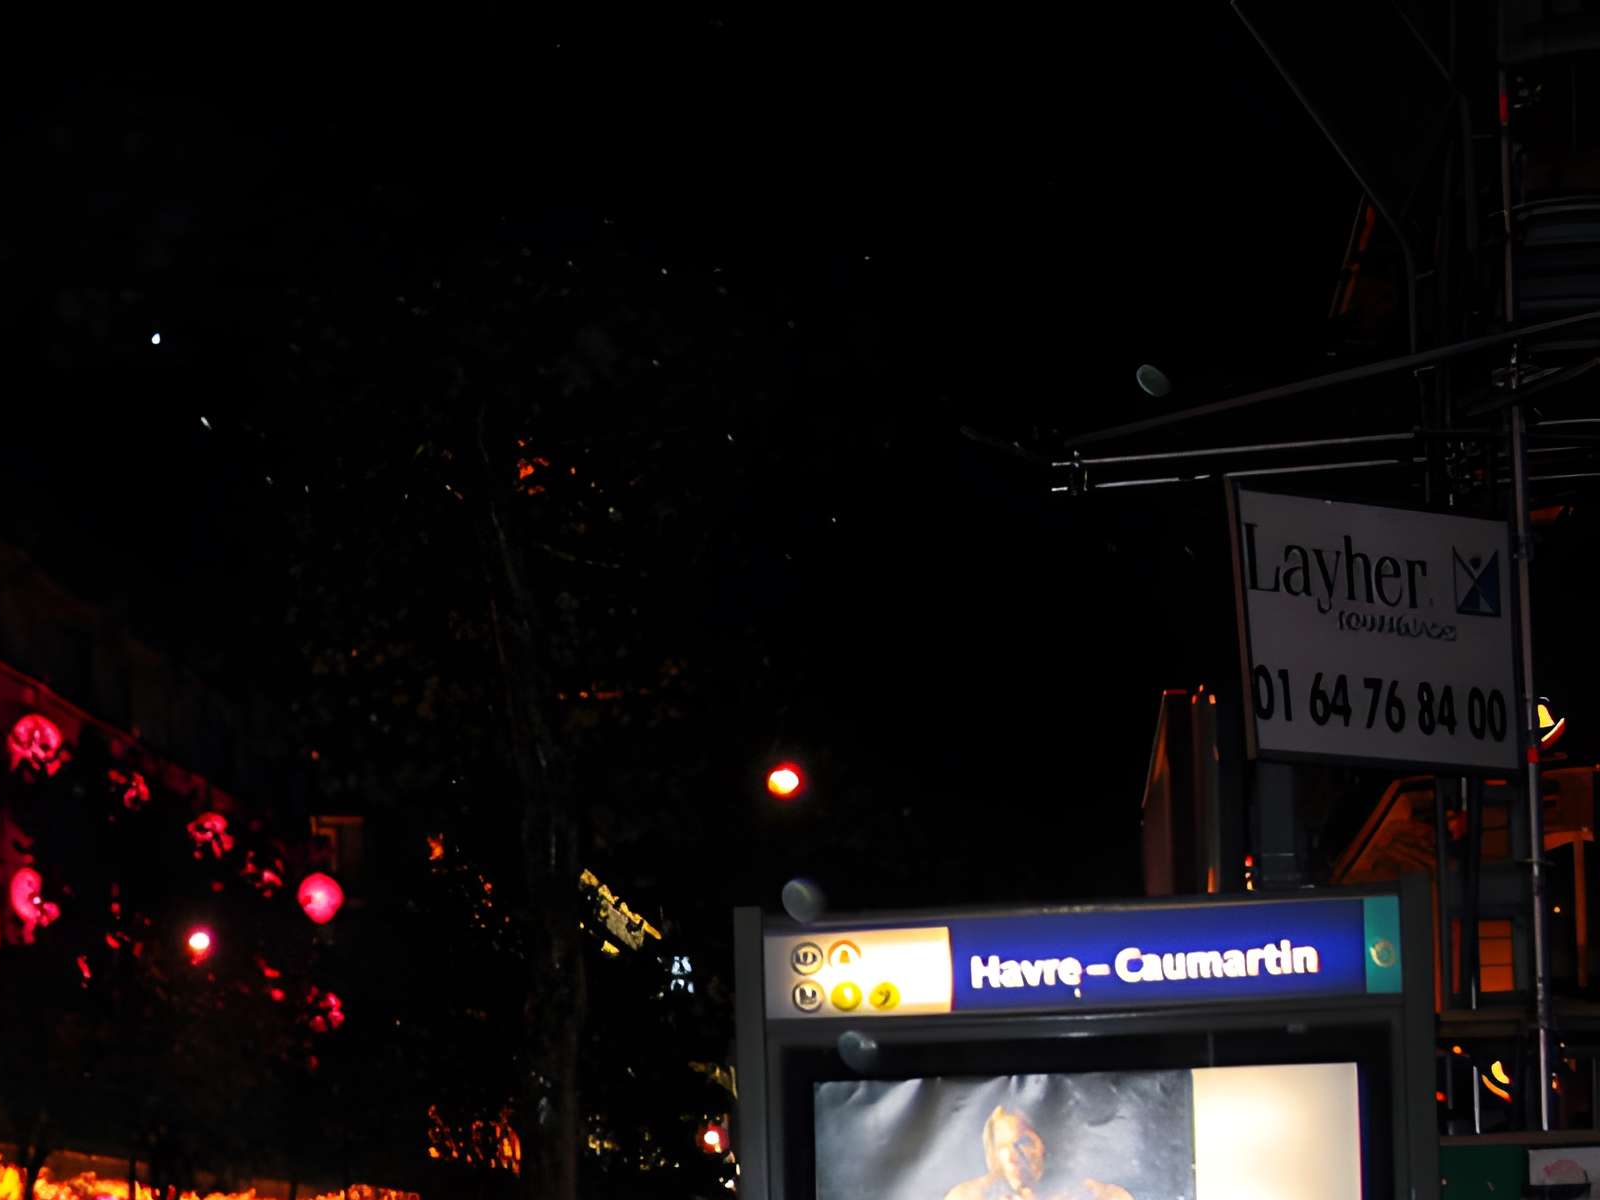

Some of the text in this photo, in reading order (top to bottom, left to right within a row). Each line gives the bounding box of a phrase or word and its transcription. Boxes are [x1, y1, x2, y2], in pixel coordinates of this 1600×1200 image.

[1243, 522, 1428, 614] Layher
[1253, 664, 1507, 743] 01 64 76 84 00
